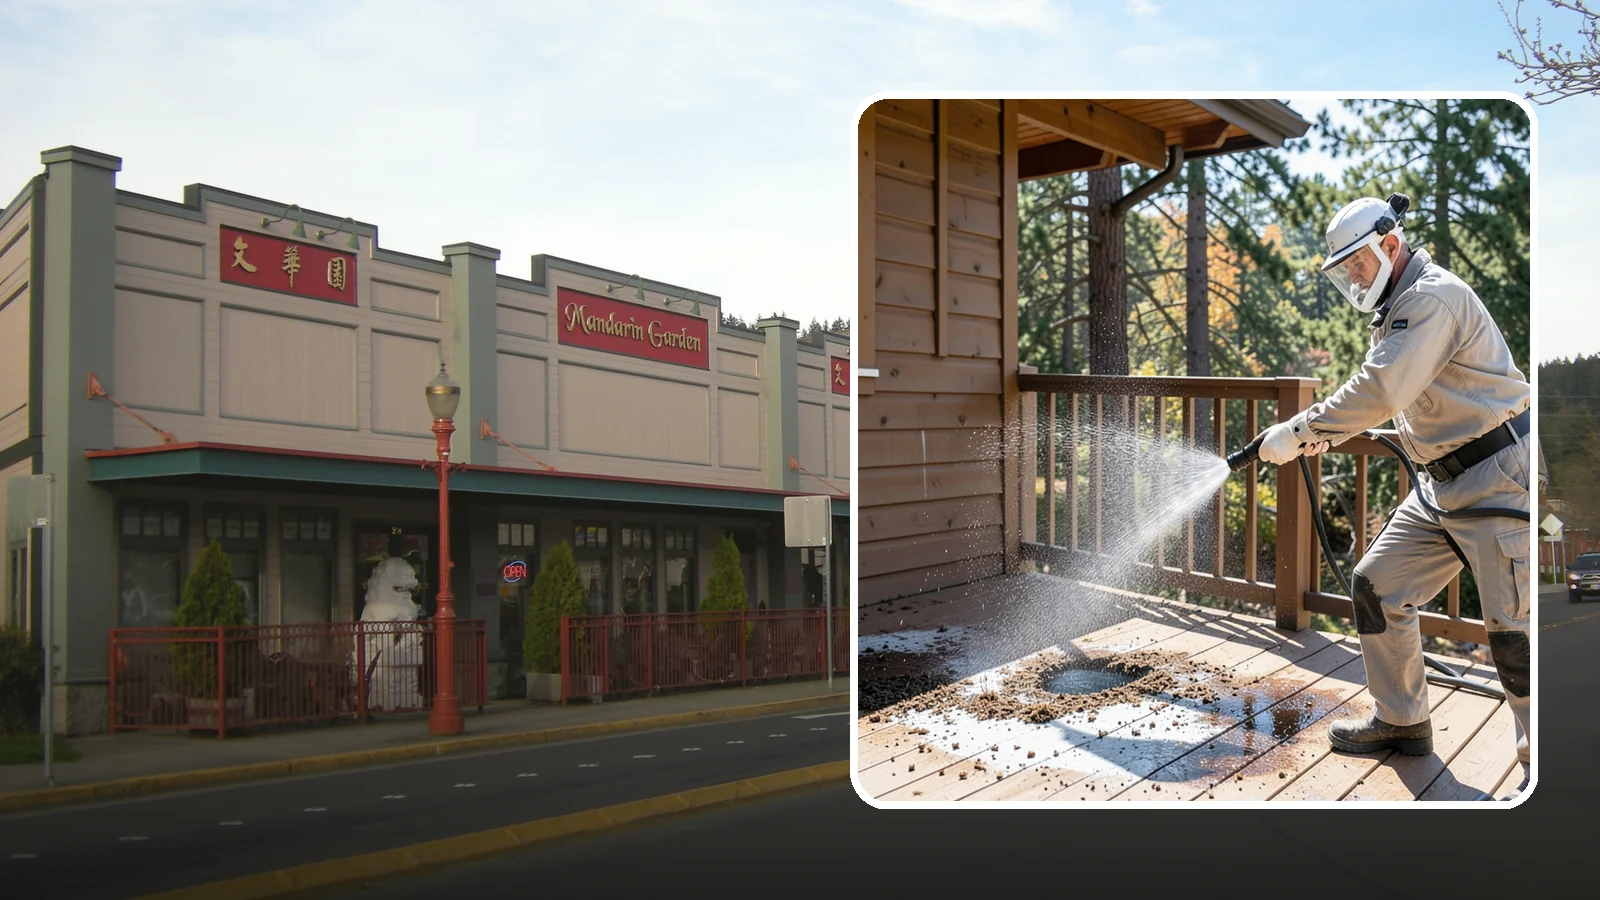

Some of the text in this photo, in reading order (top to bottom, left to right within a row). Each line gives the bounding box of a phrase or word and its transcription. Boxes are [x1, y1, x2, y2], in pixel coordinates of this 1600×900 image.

[231, 236, 346, 291] 文華園
[564, 302, 701, 351] Mandarin Garden
[503, 565, 527, 578] OPEN
